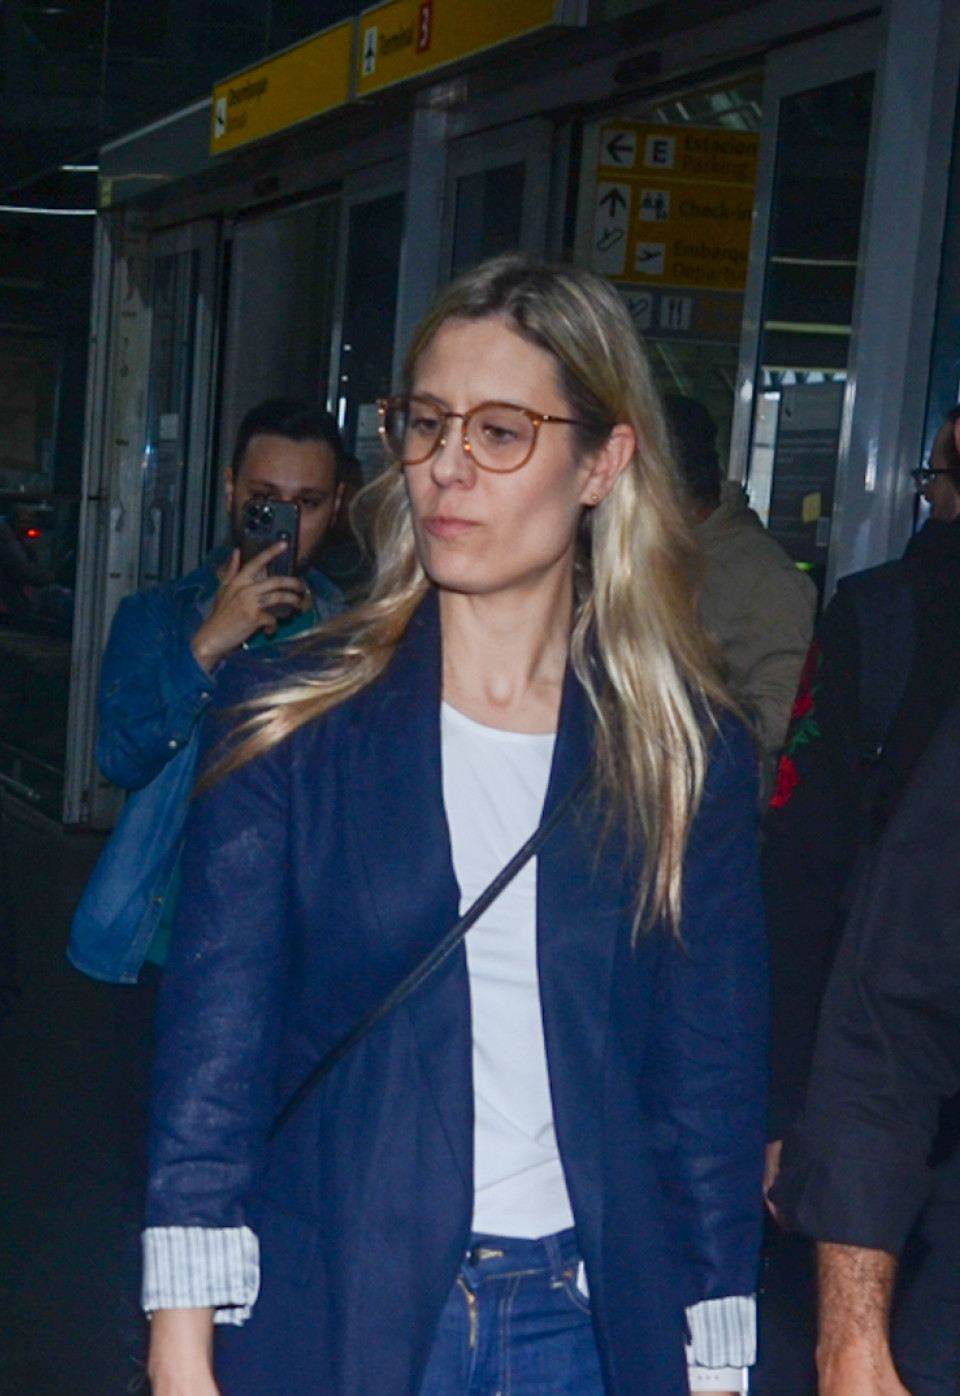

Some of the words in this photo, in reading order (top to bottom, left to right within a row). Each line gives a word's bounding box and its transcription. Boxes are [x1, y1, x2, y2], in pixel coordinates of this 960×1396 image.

[380, 19, 415, 56] Terminal
[420, 7, 429, 47] 3
[652, 139, 668, 163] E
[682, 153, 749, 181] Parking
[678, 199, 752, 222] Check-in
